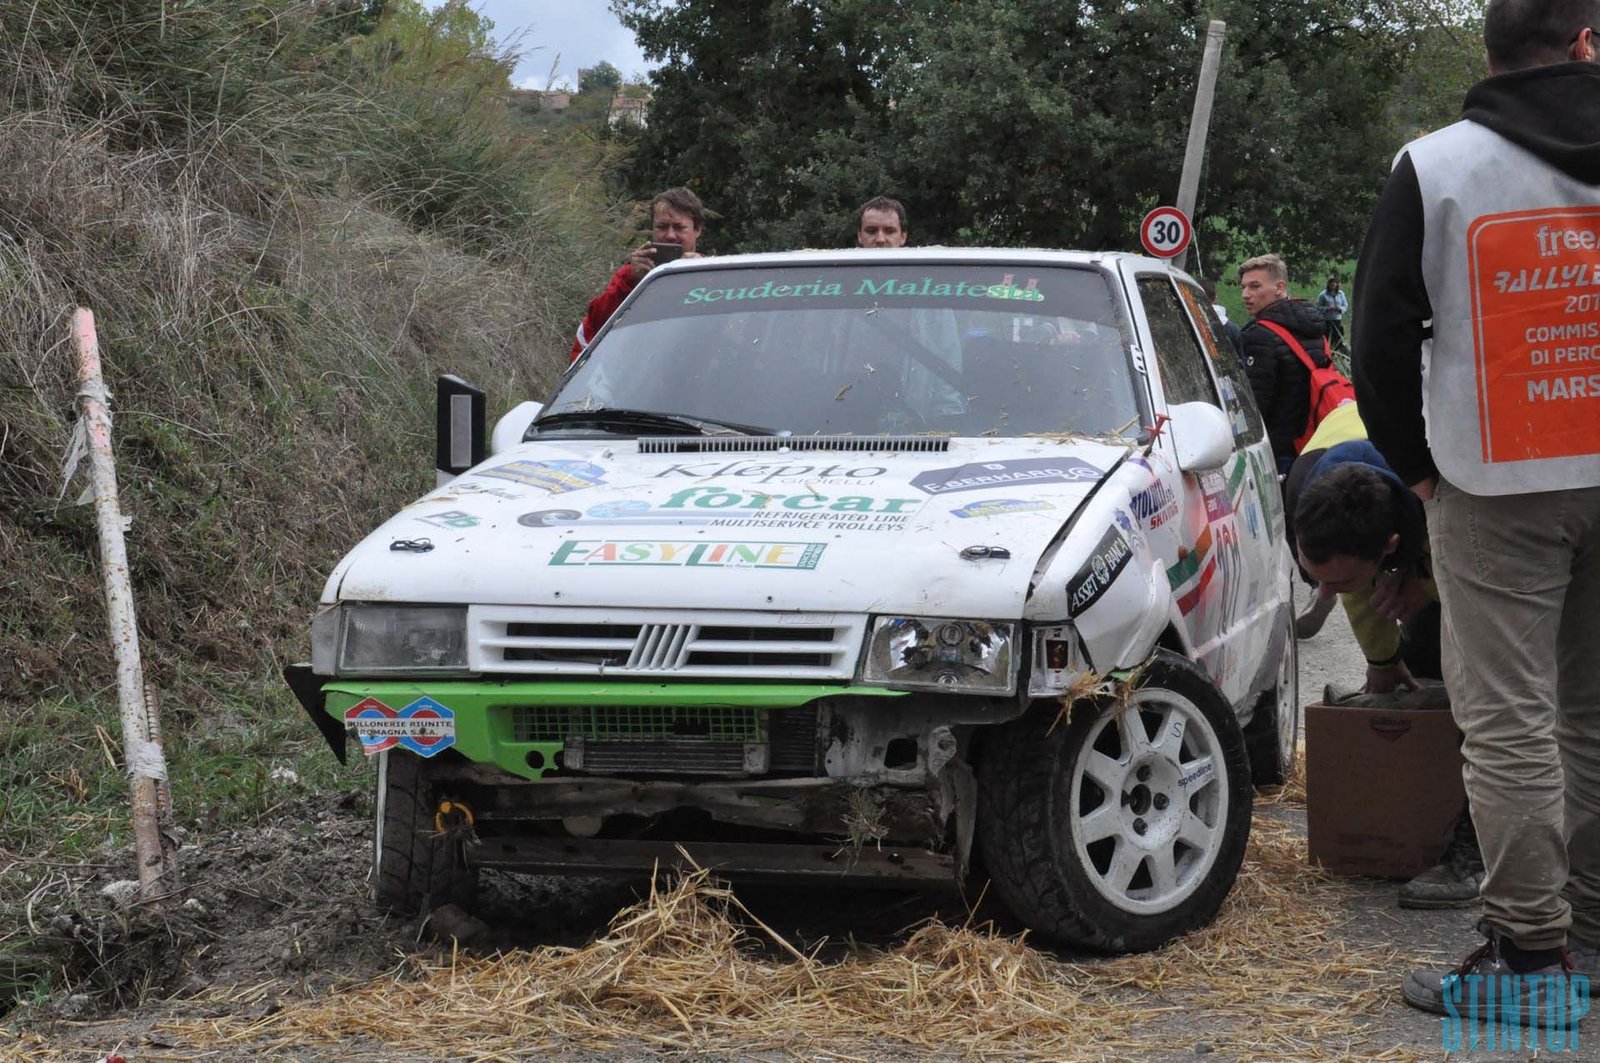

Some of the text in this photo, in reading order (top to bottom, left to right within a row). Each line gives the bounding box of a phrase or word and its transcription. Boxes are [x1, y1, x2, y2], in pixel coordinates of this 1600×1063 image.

[1153, 220, 1180, 244] 30
[1537, 225, 1600, 257] free
[684, 277, 842, 305] Scuderia
[1525, 322, 1600, 343] COMMIS
[1531, 349, 1549, 366] DI
[653, 460, 888, 484] Klepto
[658, 486, 925, 513] forcar
[708, 518, 906, 532] MULTISERVICE TROLLEYS
[753, 511, 911, 523] REFRIGERATED LINE
[1071, 537, 1131, 612] ASSET BANCA
[347, 720, 453, 728] BULLONERIE RIUNITE
[1178, 764, 1212, 787] speedline
